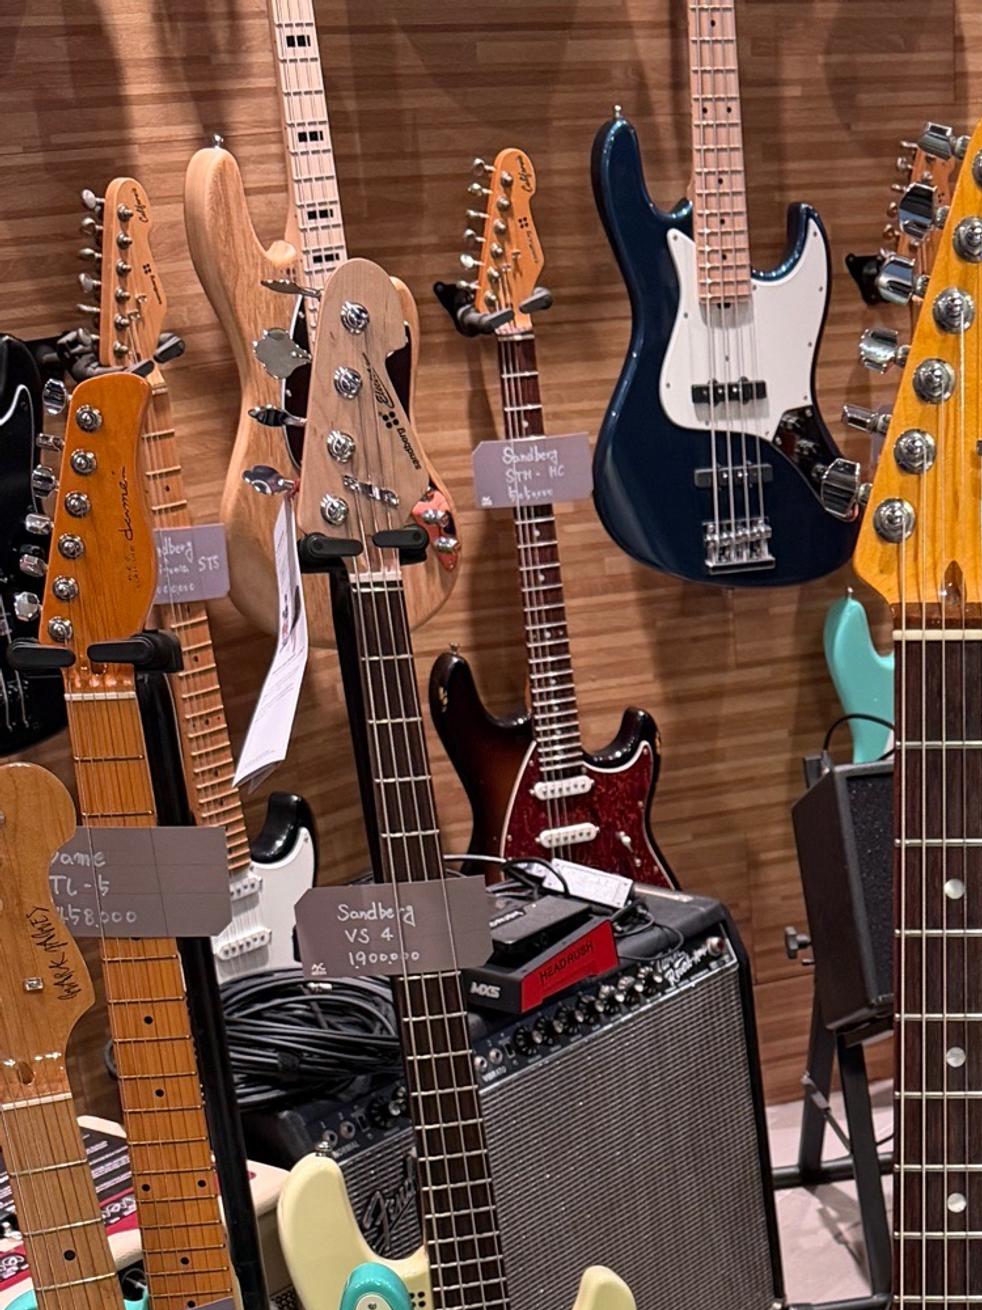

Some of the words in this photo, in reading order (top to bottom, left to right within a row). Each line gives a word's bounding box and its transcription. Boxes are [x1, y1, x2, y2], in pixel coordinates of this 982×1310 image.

[396, 427, 422, 470] sandberg
[502, 444, 560, 465] Sandberg
[336, 901, 417, 928] Sandberg
[344, 928, 370, 944] VS
[380, 926, 395, 942] 4
